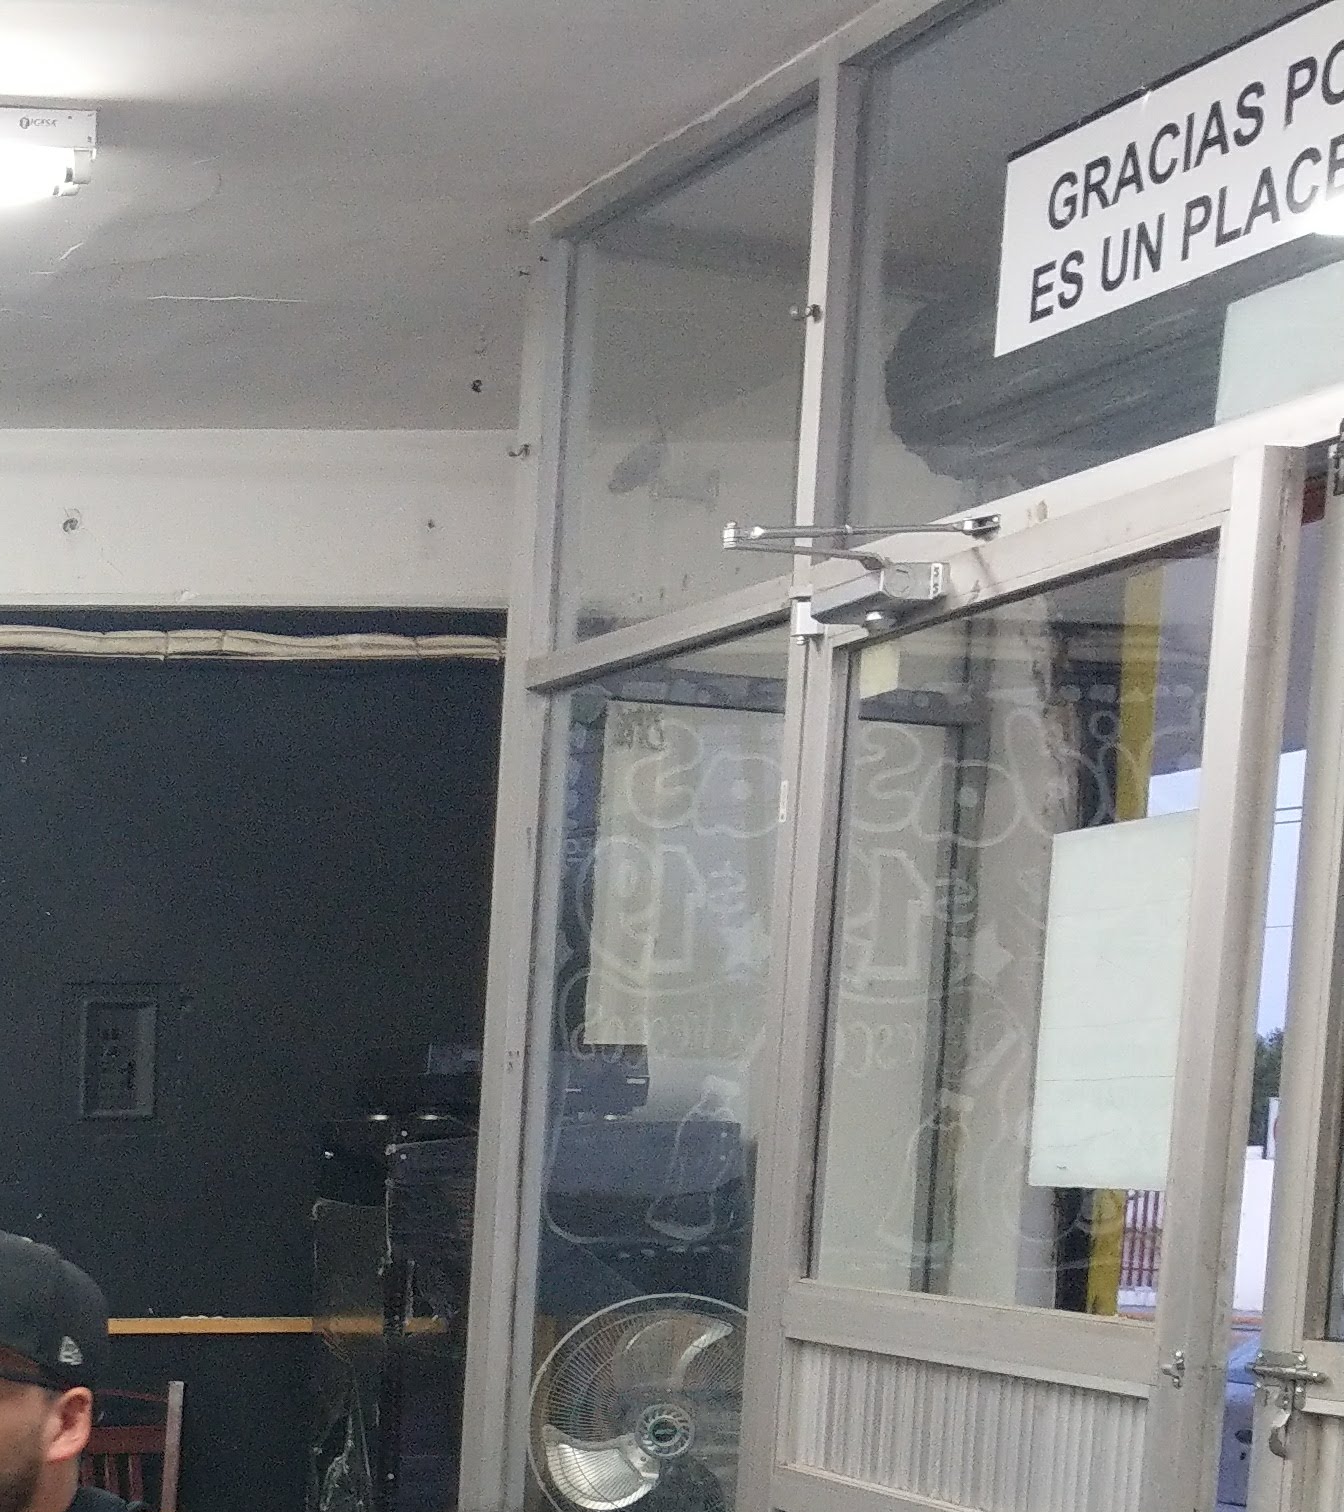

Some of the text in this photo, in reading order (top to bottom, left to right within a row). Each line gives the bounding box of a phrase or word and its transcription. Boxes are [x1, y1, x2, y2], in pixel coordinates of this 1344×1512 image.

[1048, 80, 1265, 230] GRACIAS
[1029, 250, 1085, 324] ES
[1100, 213, 1165, 292] UN
